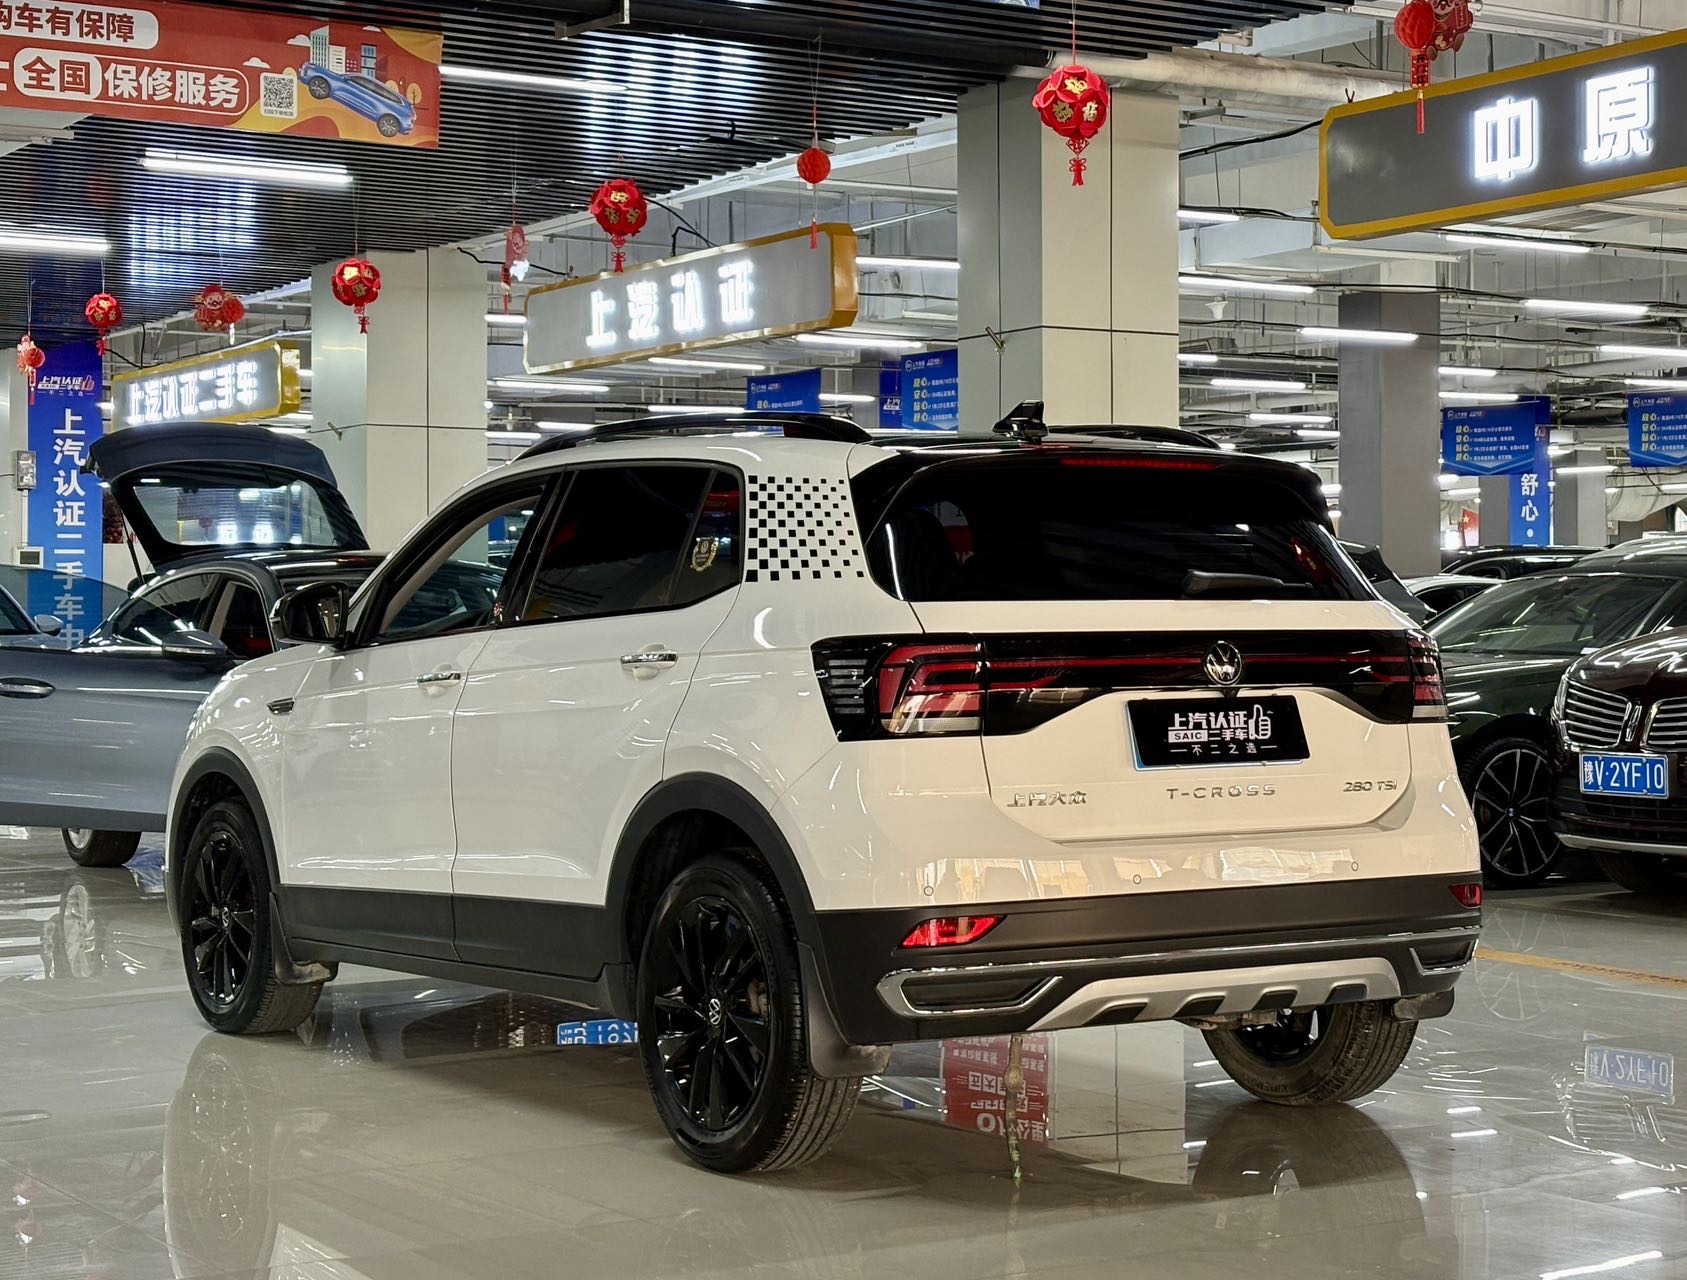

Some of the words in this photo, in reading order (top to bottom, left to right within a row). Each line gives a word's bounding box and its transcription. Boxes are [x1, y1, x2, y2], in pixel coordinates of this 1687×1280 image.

[0, 56, 241, 108] 全国保修服务
[1168, 711, 1248, 730] 上汽认证
[1174, 732, 1203, 740] SAIC
[1208, 729, 1248, 741] 二手车
[1166, 784, 1276, 800] T-CROSS
[1342, 782, 1373, 793] 280
